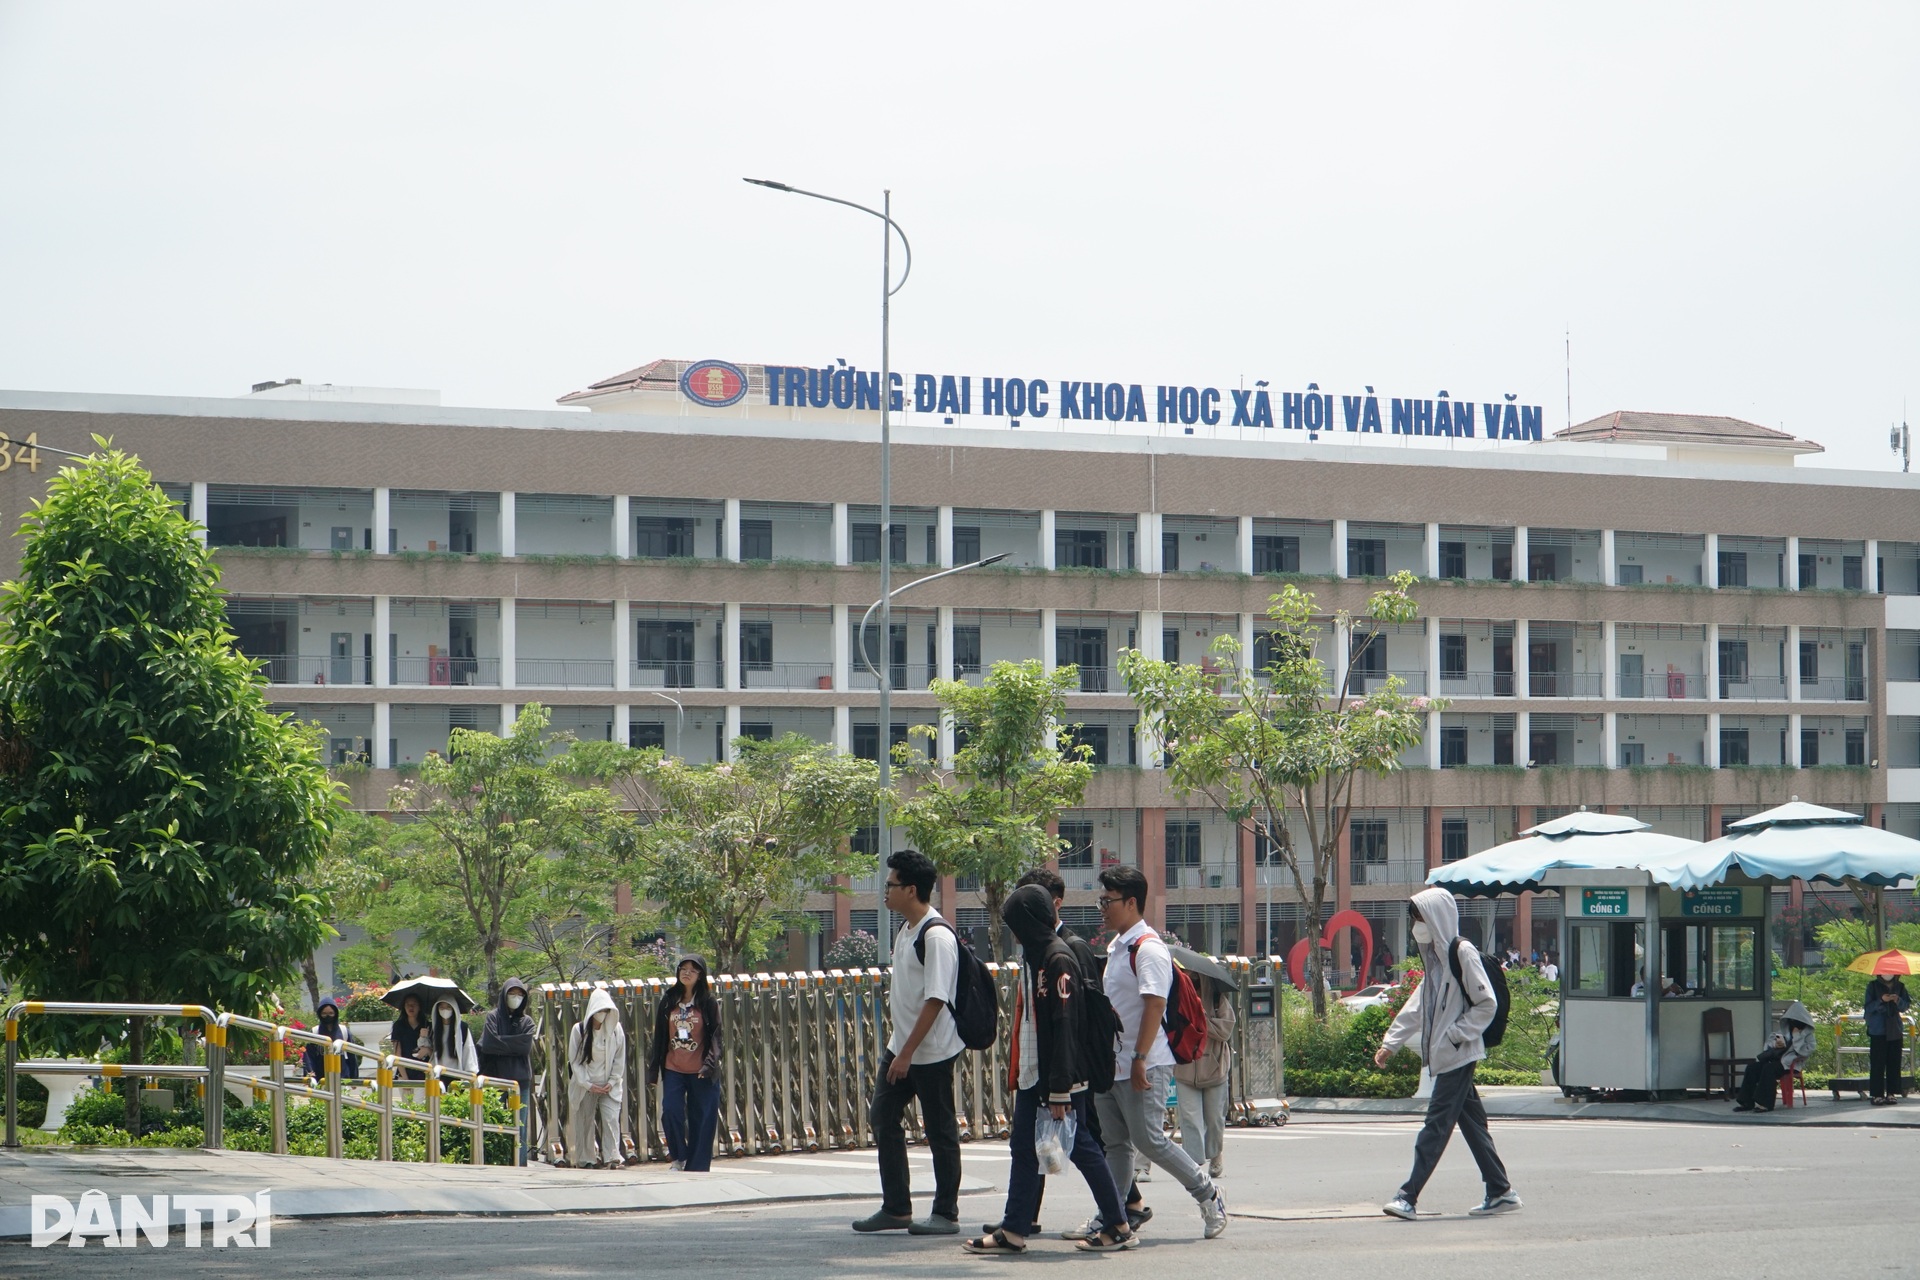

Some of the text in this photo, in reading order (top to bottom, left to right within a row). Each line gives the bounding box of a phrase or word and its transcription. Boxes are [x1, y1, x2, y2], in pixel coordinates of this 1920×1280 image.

[764, 358, 903, 411] TRƯỜNG
[914, 375, 970, 425] ĐẠI
[982, 378, 1048, 427] HỌC
[1060, 381, 1147, 422] KHOA
[1157, 386, 1220, 434] HỌC
[1231, 380, 1273, 427] XÃ
[1283, 383, 1333, 440] HỘI
[1342, 385, 1382, 433] VÀ
[1391, 390, 1474, 437] NHÂN
[1483, 393, 1542, 441] VĂN
[1614, 904, 1621, 914] C
[1724, 904, 1732, 914] C
